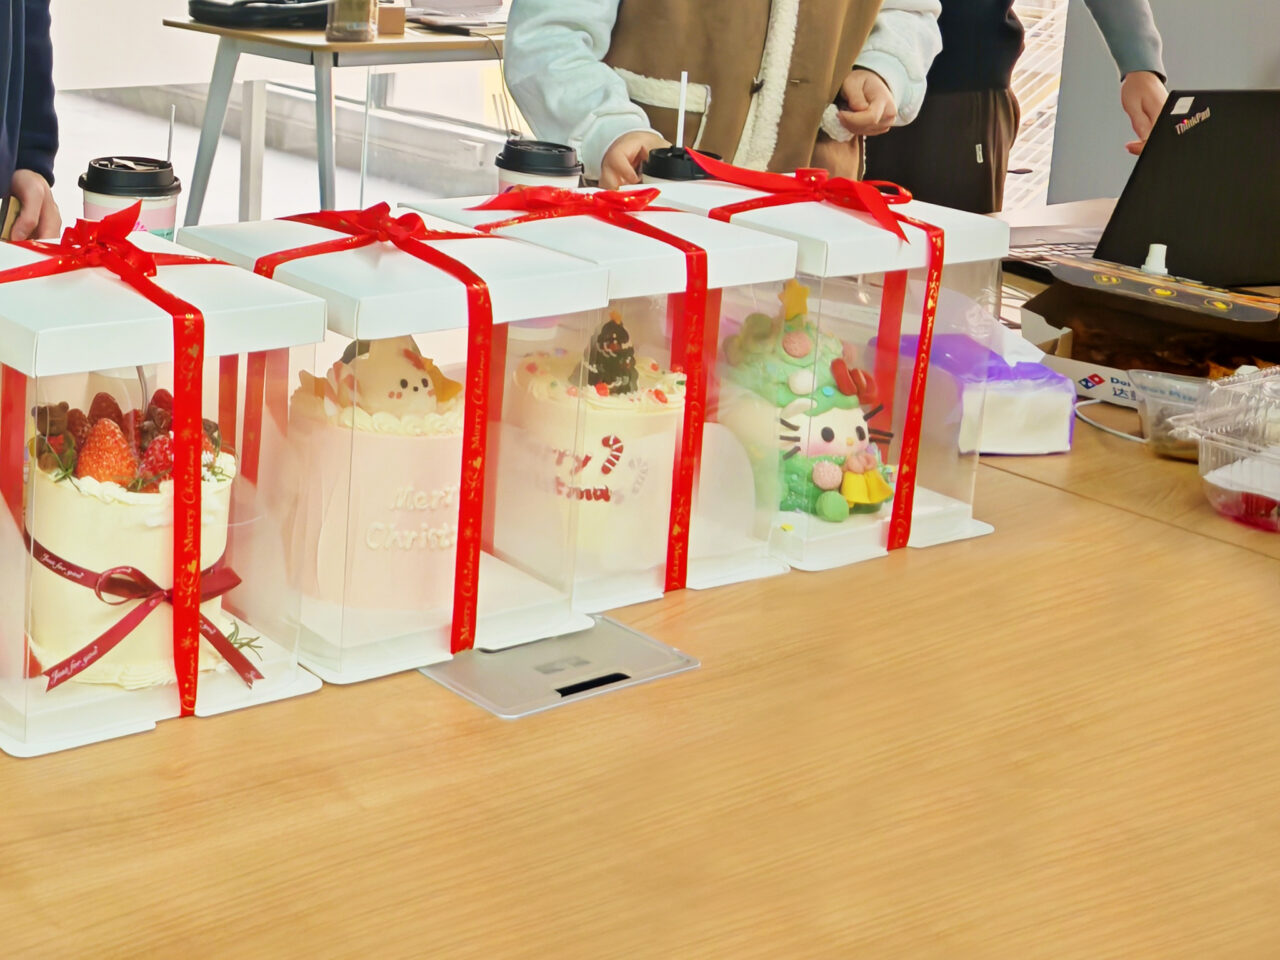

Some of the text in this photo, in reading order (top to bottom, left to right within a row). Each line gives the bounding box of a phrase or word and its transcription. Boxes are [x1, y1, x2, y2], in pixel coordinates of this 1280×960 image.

[1175, 107, 1211, 135] ThinkPad
[470, 408, 484, 449] Merry
[183, 508, 197, 552] Merry
